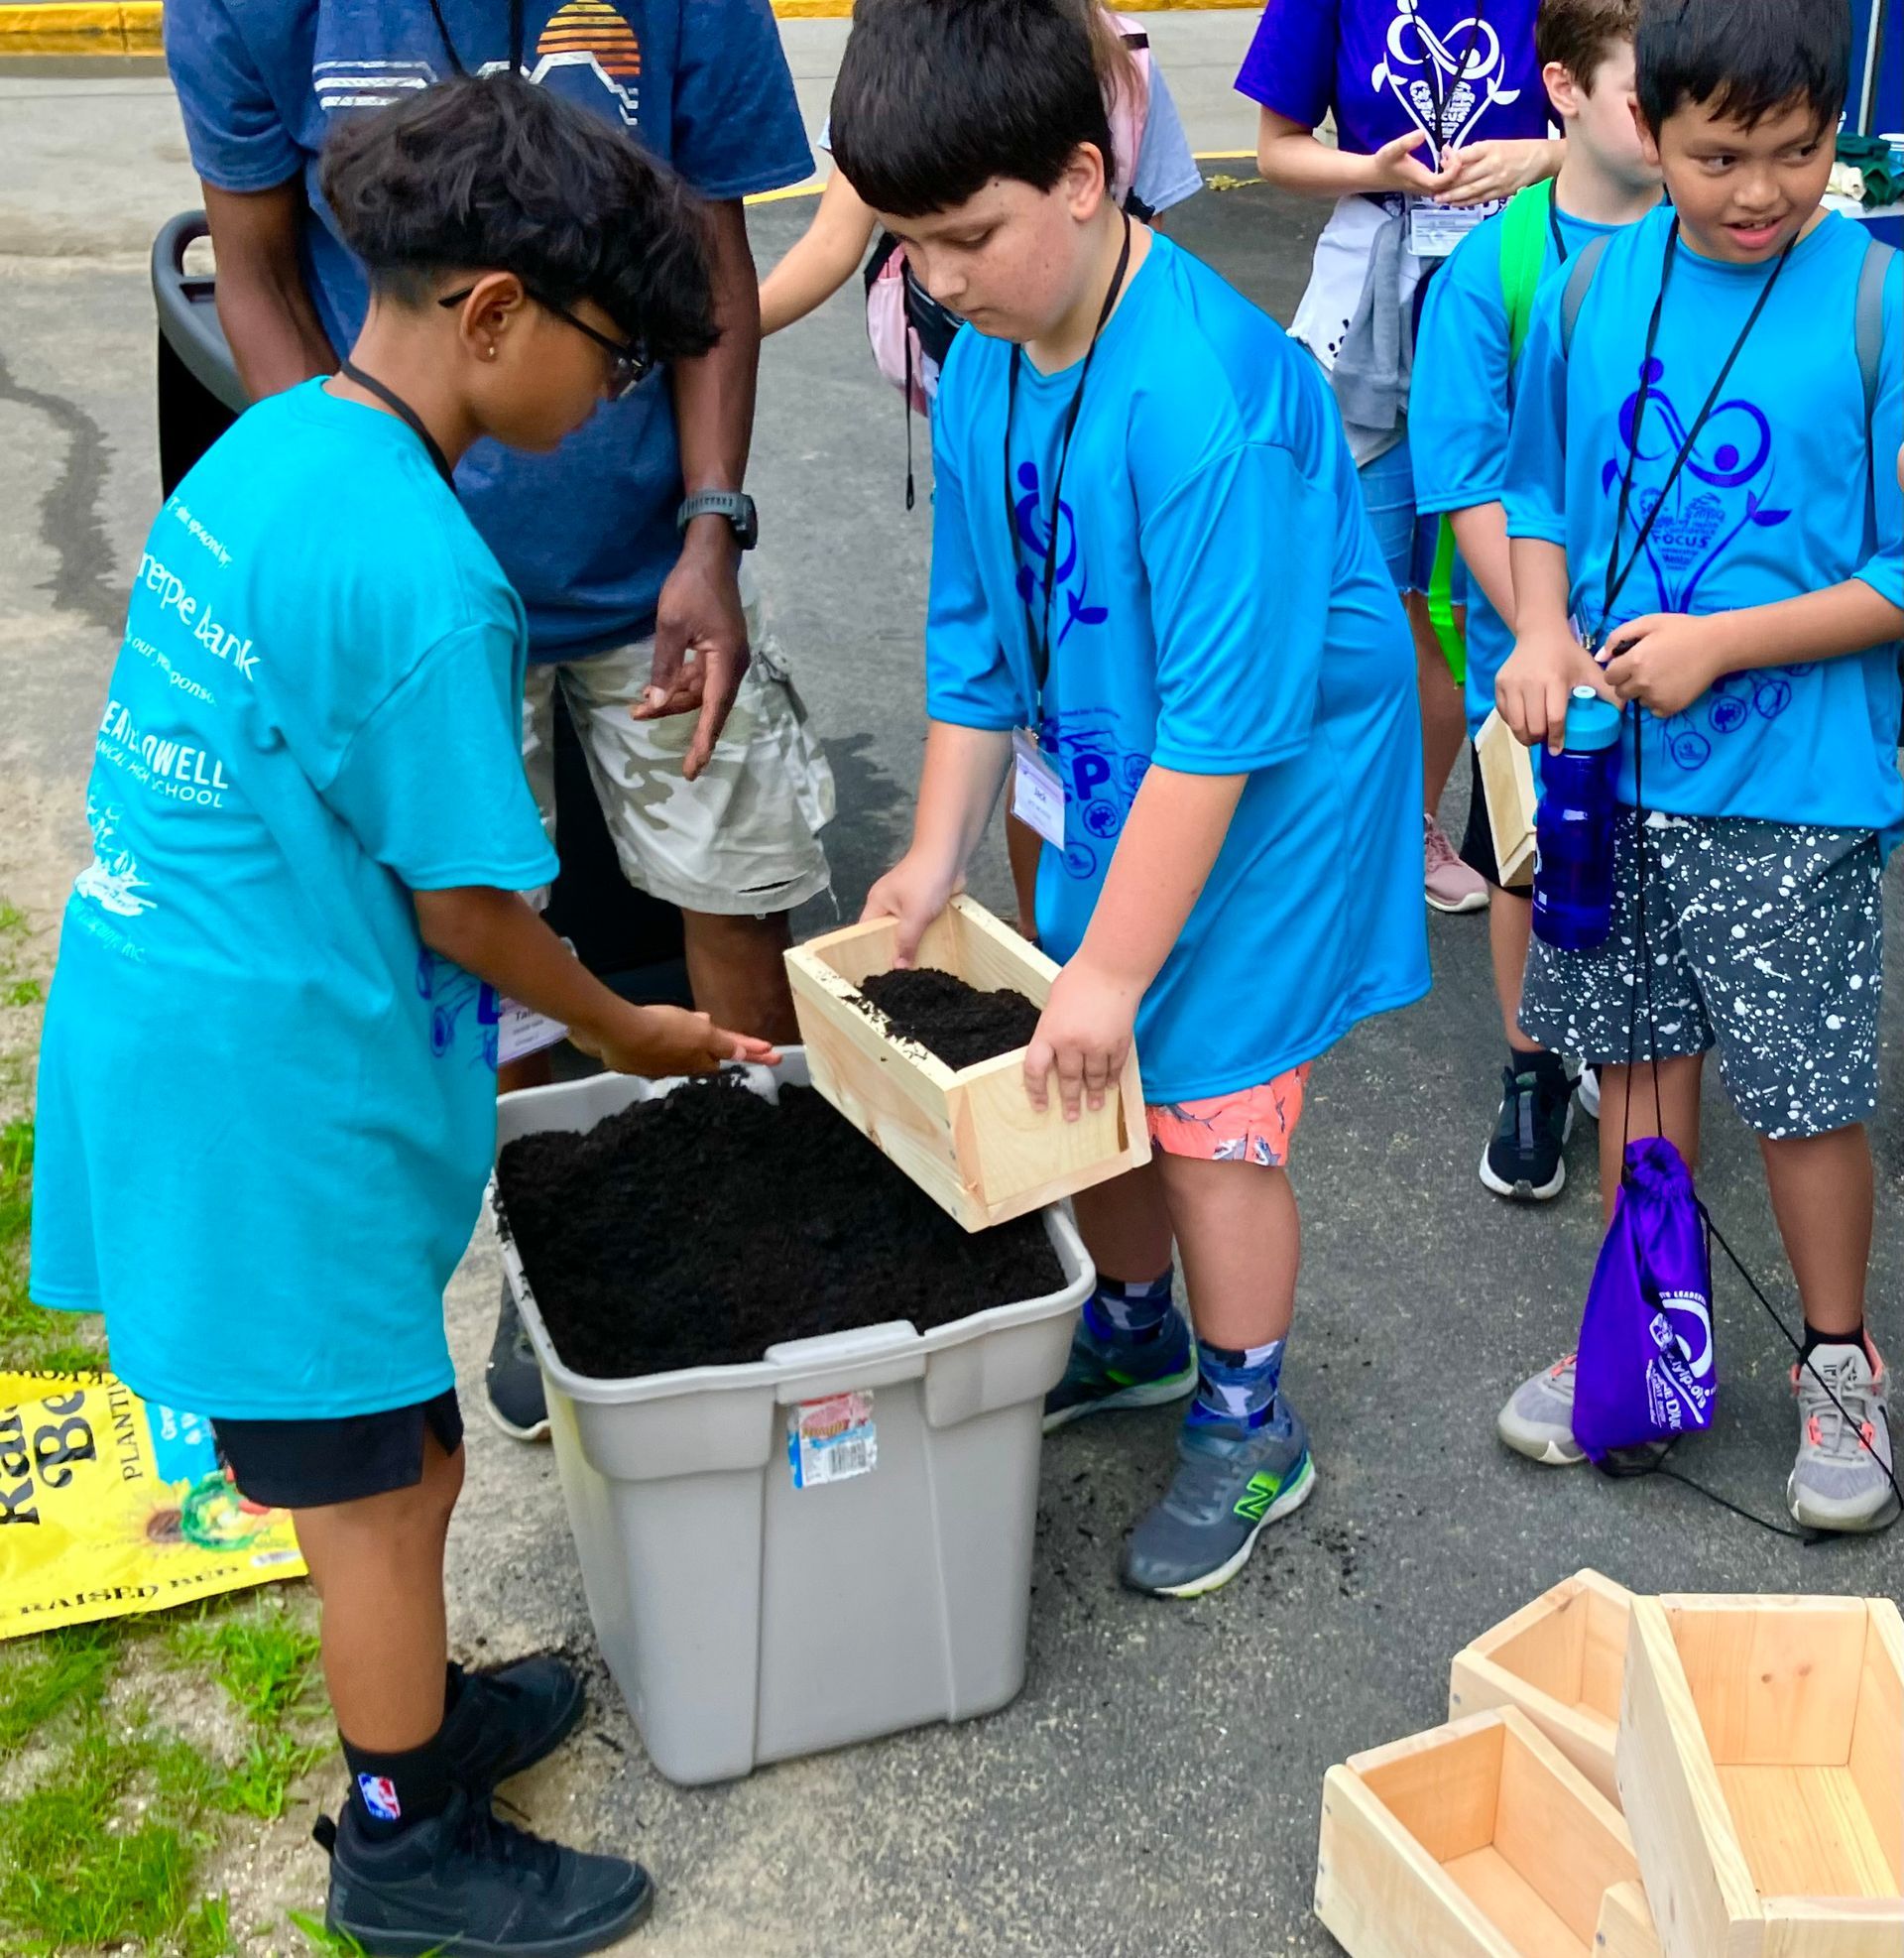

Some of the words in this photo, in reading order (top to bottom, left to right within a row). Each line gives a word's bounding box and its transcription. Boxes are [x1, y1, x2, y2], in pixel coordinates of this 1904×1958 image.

[1651, 531, 1712, 549] FOCUS
[132, 637, 156, 659] our
[193, 602, 261, 682] bank
[1674, 1290, 1707, 1307] LEADER
[33, 1389, 97, 1489] Be
[19, 1584, 159, 1616] RAISED
